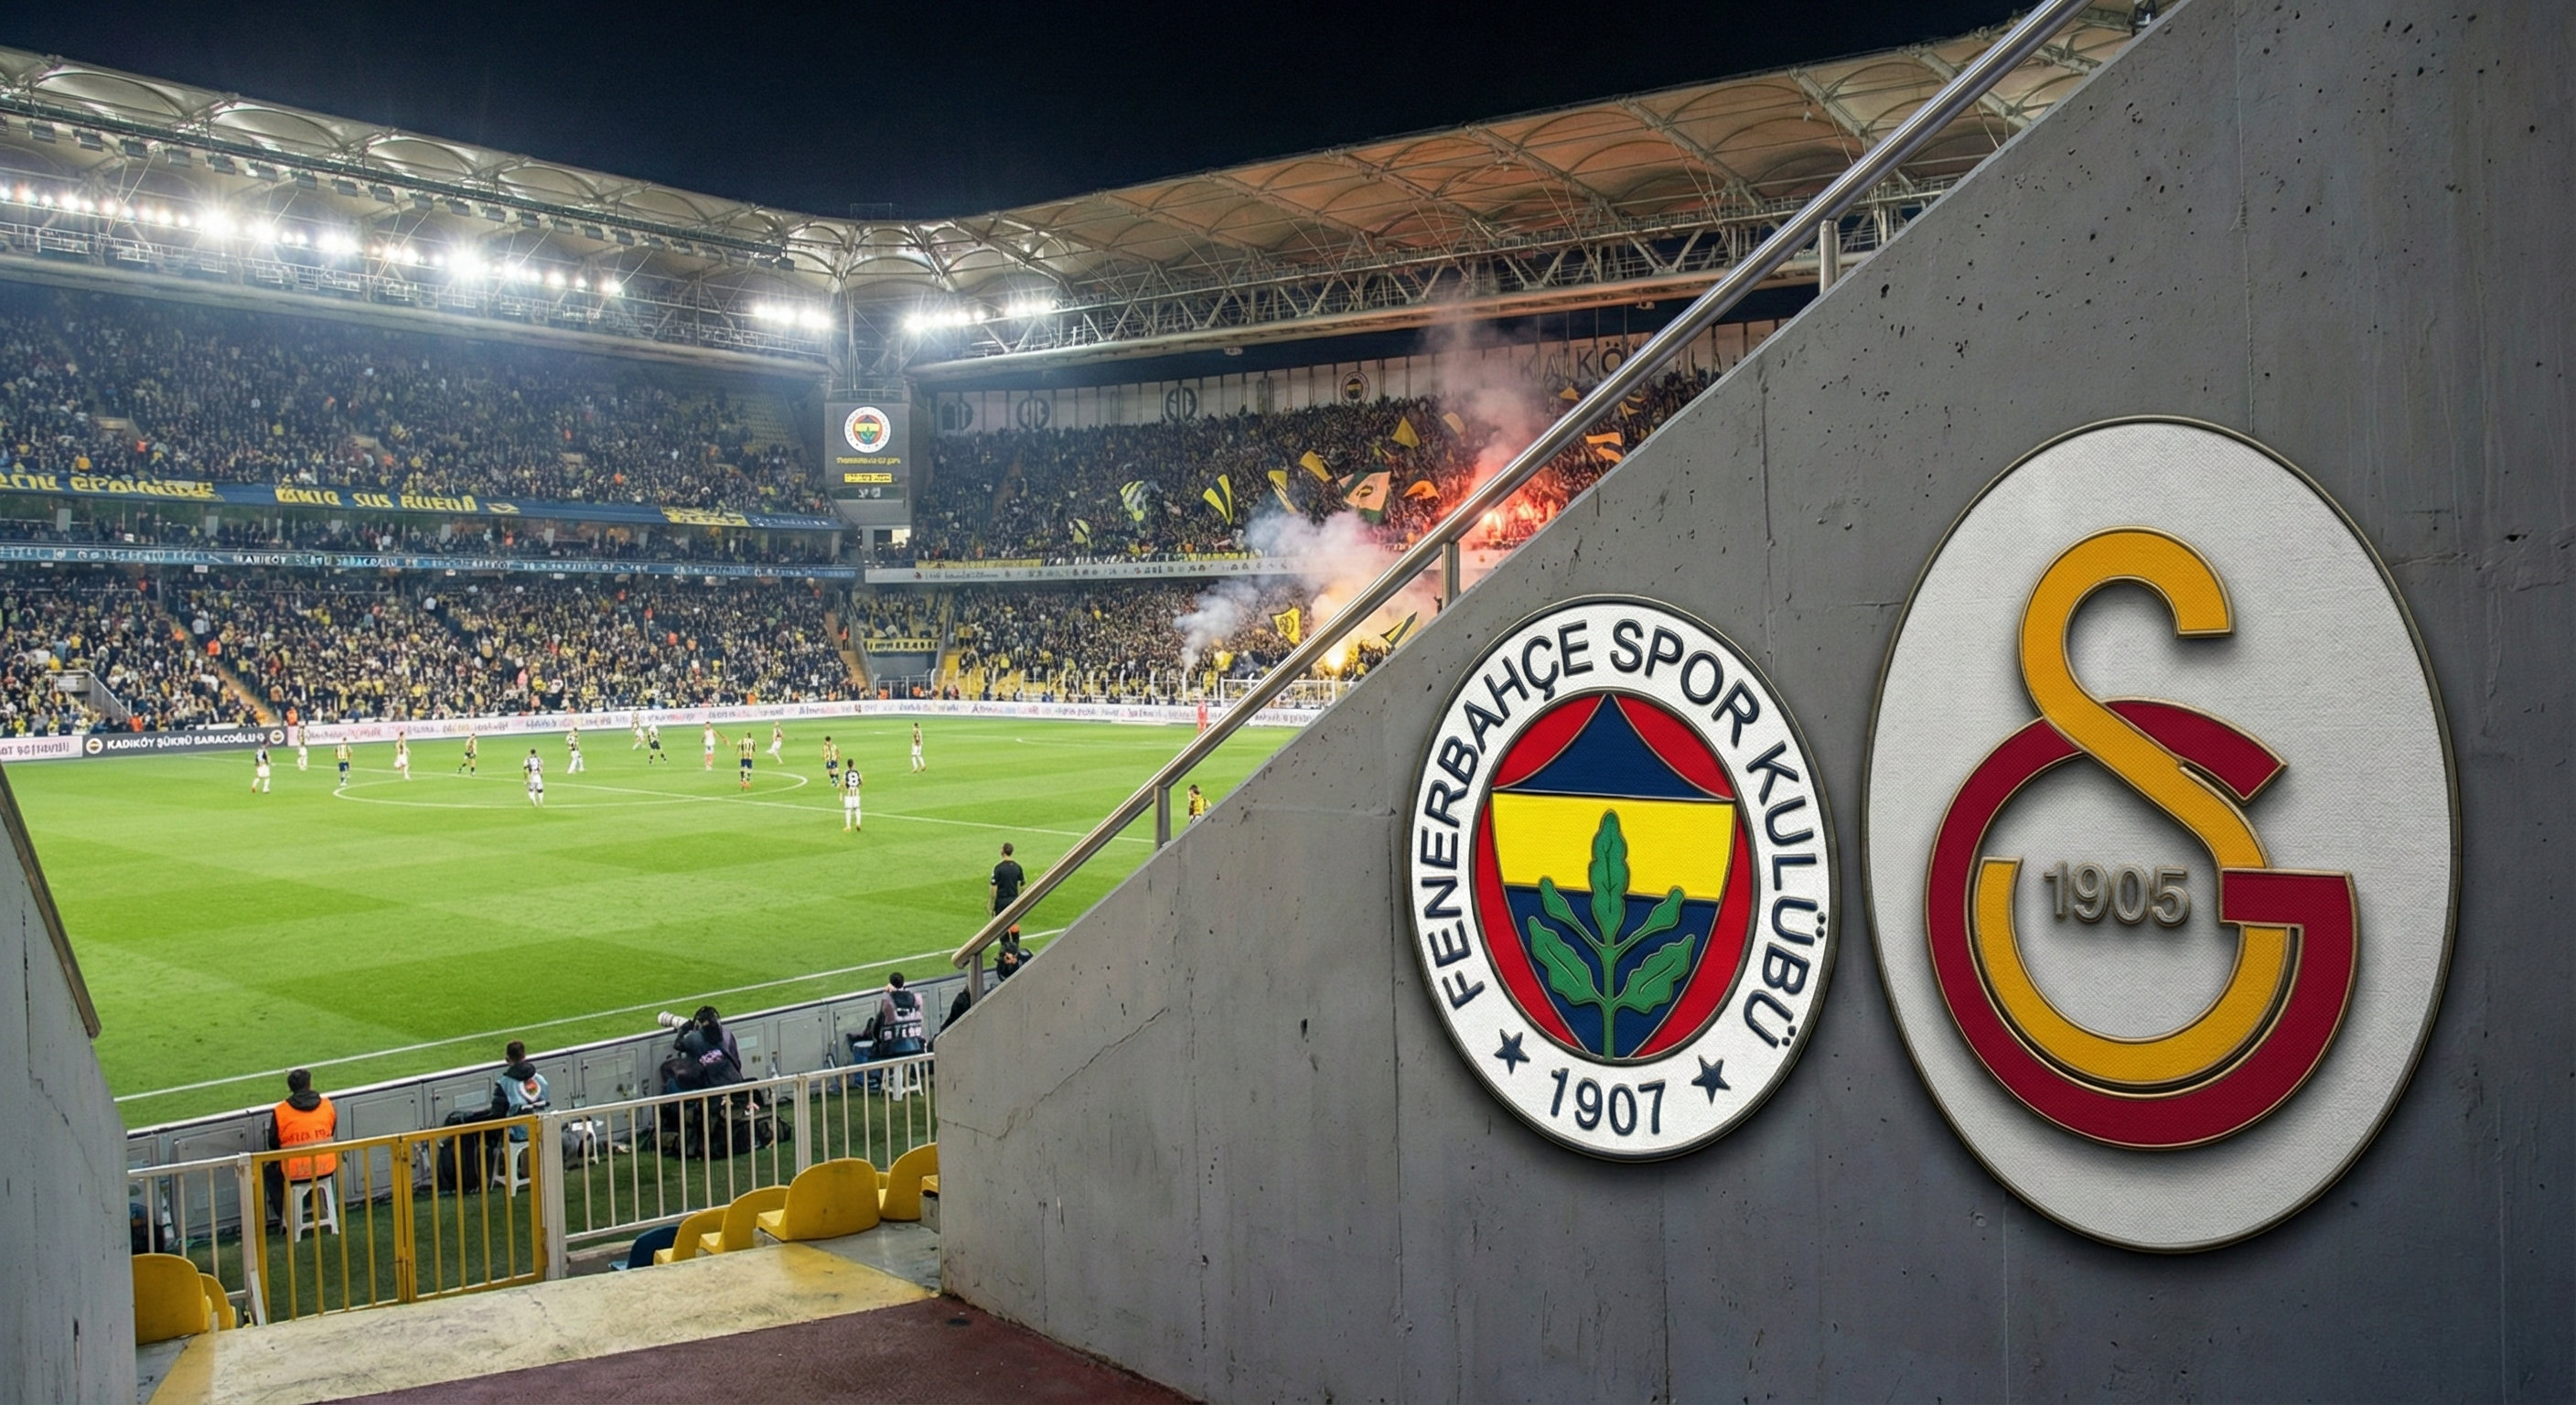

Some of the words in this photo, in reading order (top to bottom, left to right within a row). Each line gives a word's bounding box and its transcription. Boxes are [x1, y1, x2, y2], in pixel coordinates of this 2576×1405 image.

[1421, 619, 1594, 1009] FENERBAHÇE
[1610, 618, 1760, 748] SPOR
[1744, 740, 1826, 1049] KULÜBÜ
[2044, 862, 2190, 927] 1905
[1551, 1067, 1667, 1136] 1907
